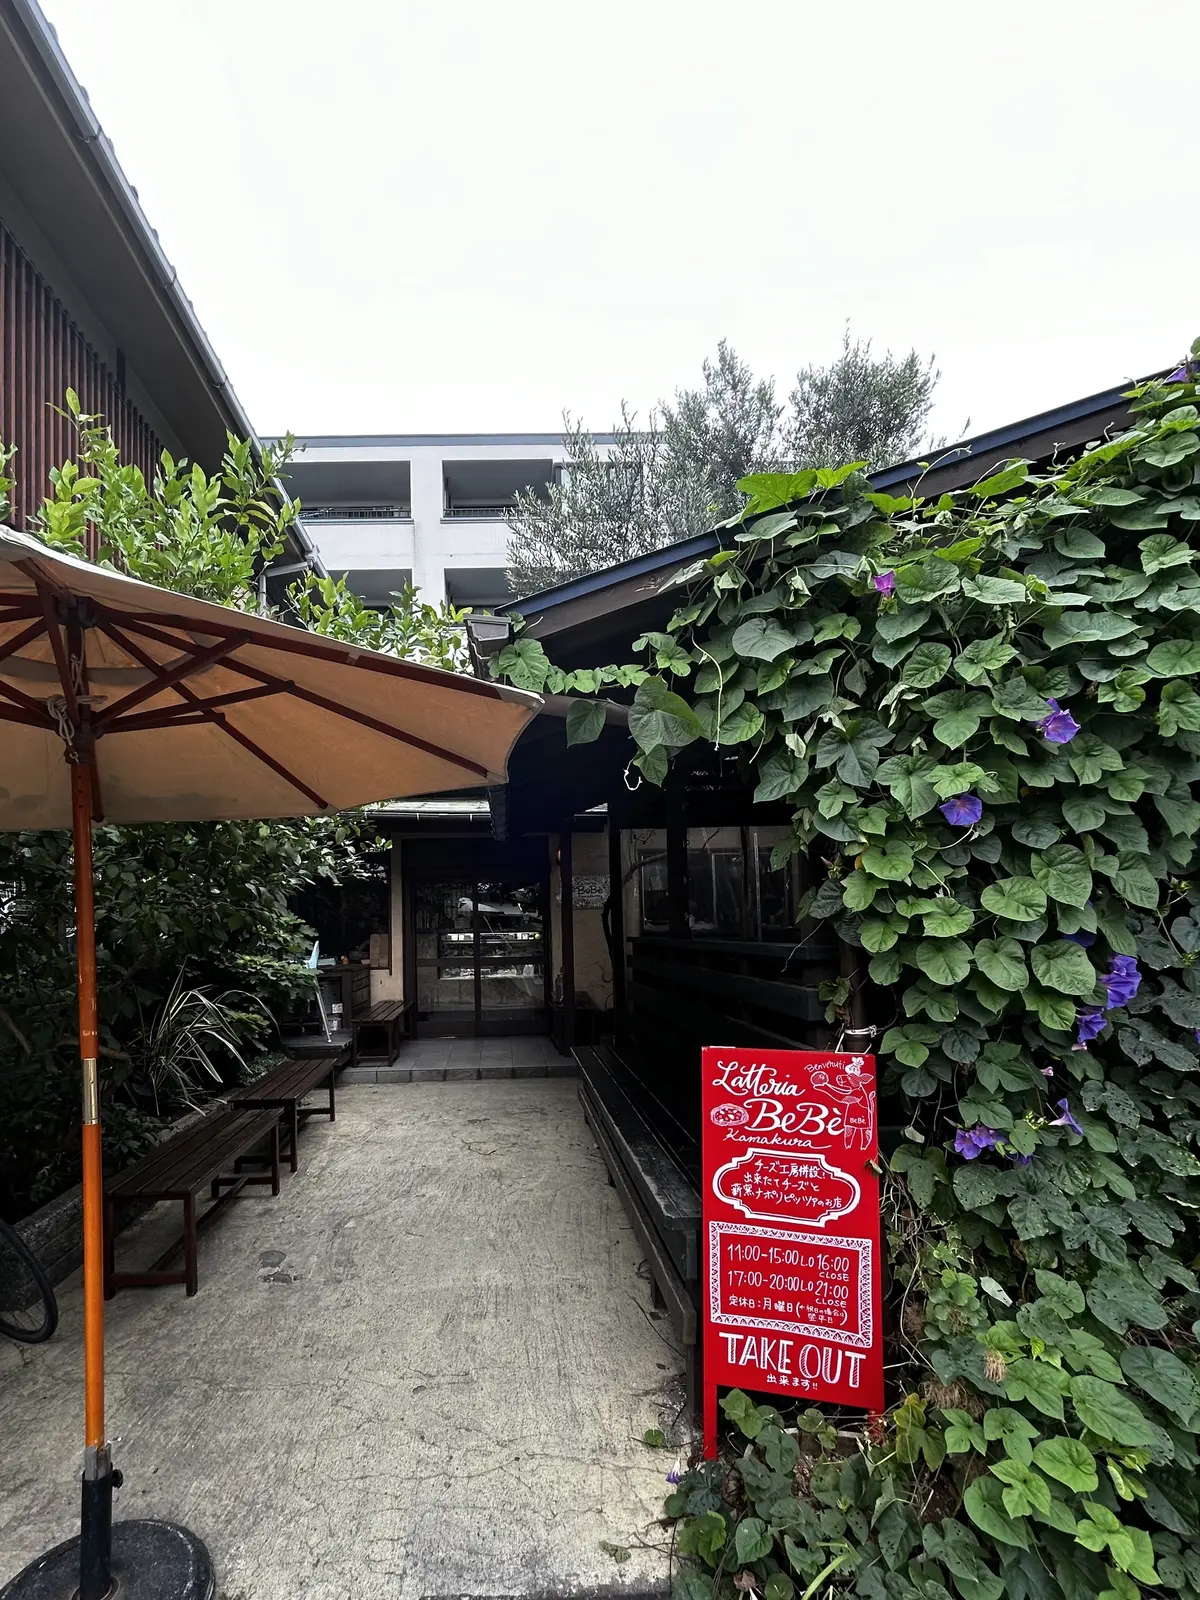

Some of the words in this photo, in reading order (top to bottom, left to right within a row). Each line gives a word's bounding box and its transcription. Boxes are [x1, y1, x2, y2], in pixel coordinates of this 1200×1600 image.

[804, 1060, 846, 1072] Benvenuti
[712, 1060, 805, 1097] Latteria
[744, 1098, 845, 1135] BeBè
[723, 1128, 832, 1149] Kamakura
[743, 1172, 820, 1192] 出来たてチーズと
[817, 1254, 849, 1272] 16:00
[819, 1272, 849, 1281] CLOSE
[814, 1280, 849, 1299] 21:00
[815, 1298, 847, 1308] CLOSE
[719, 1331, 794, 1374] TAKE
[799, 1344, 867, 1388] OUT
